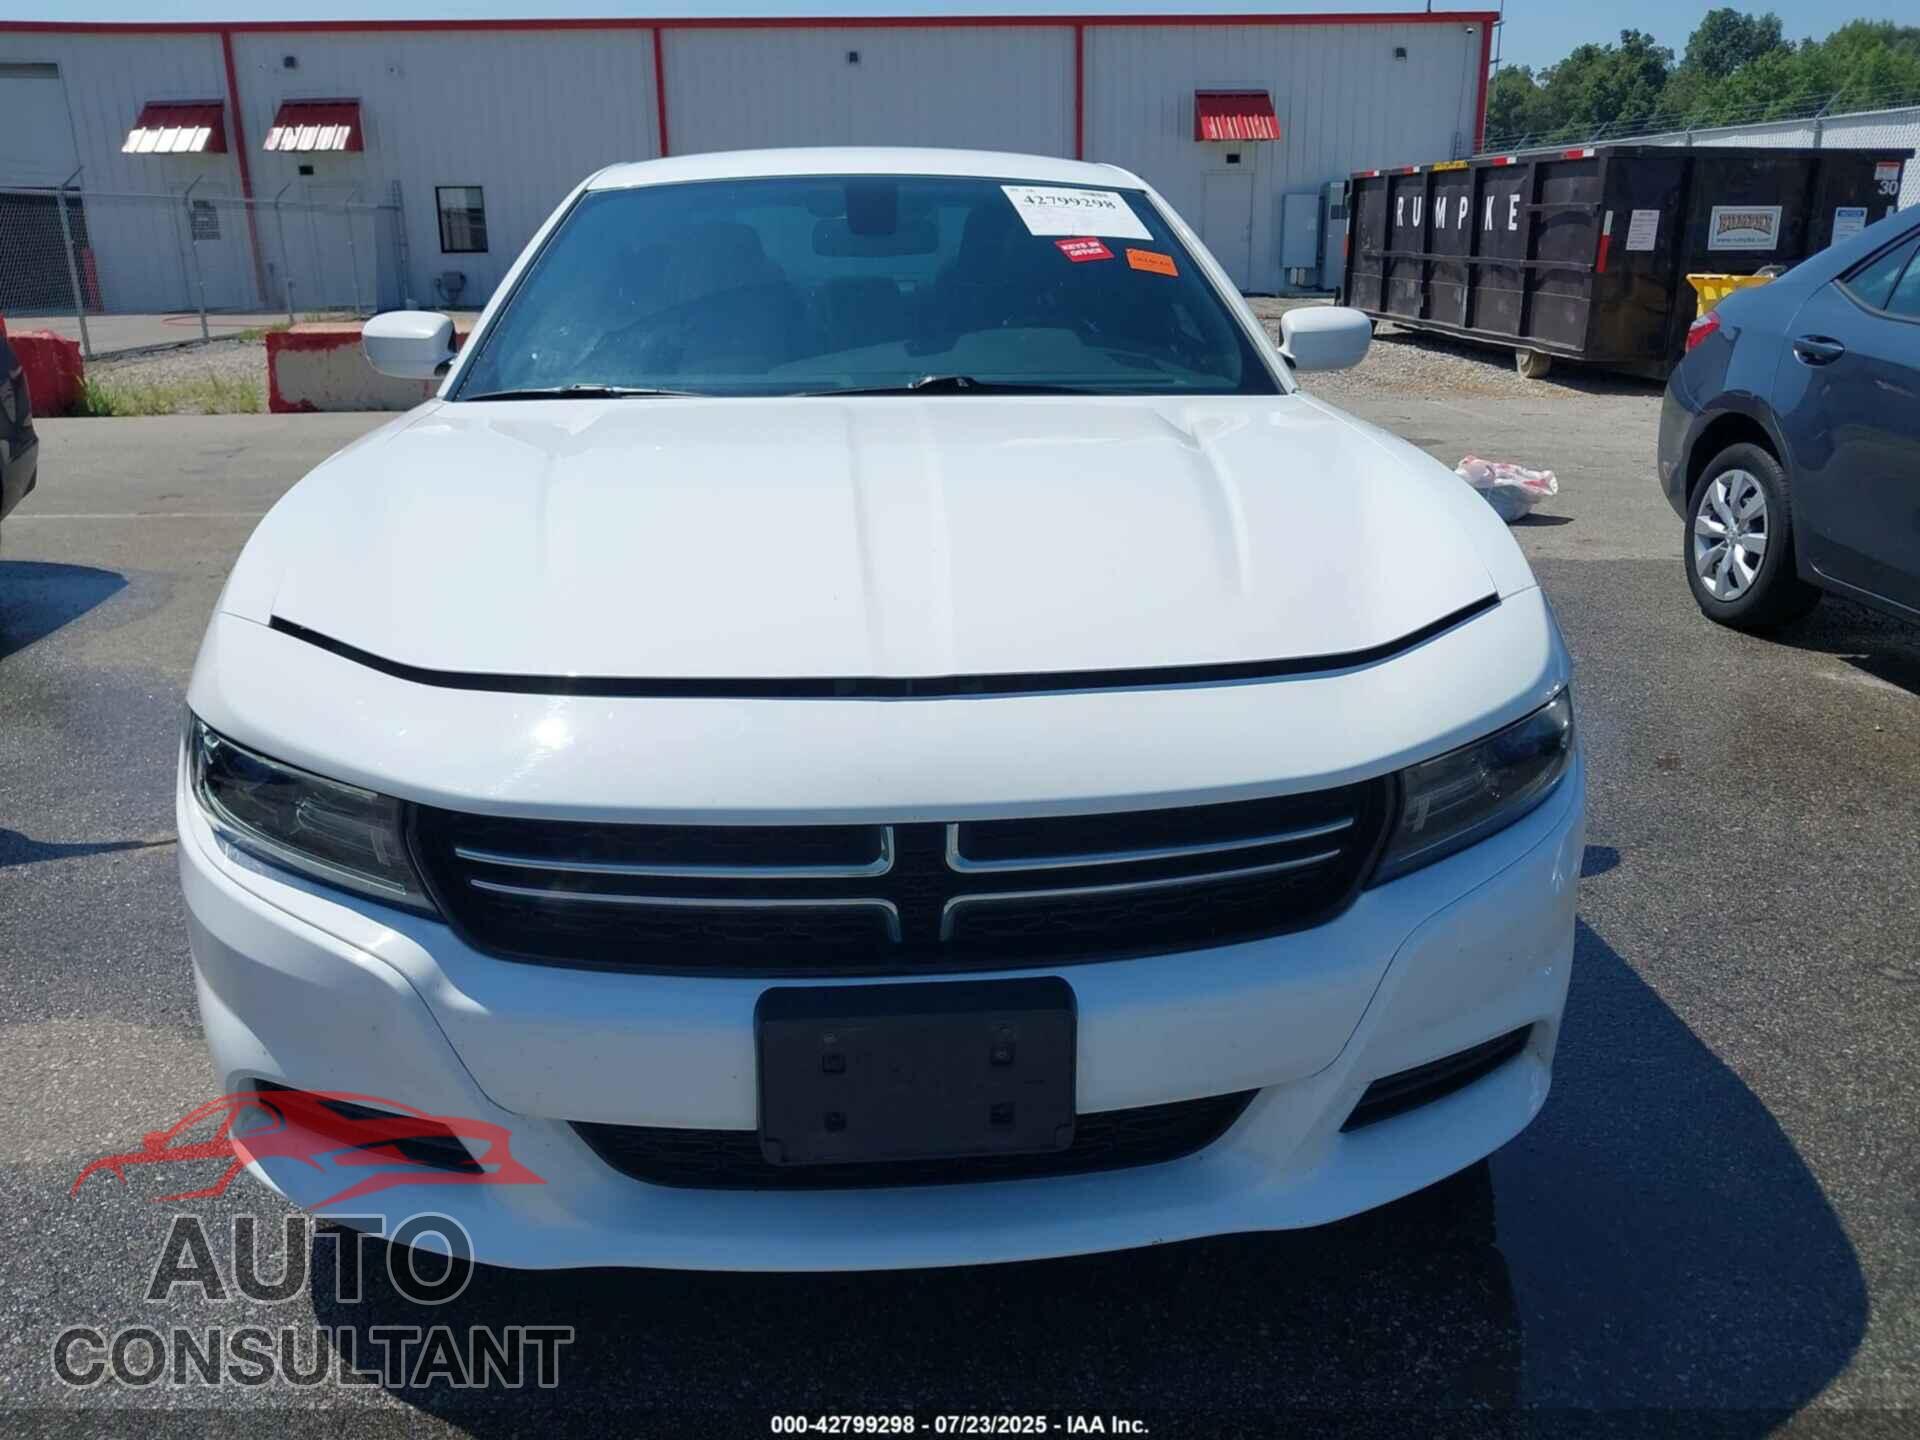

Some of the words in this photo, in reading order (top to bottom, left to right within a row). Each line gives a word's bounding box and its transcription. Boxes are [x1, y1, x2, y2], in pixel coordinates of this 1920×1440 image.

[1877, 180, 1899, 196] 30
[1023, 194, 1117, 210] 42799298
[1396, 193, 1520, 231] RUMPKE
